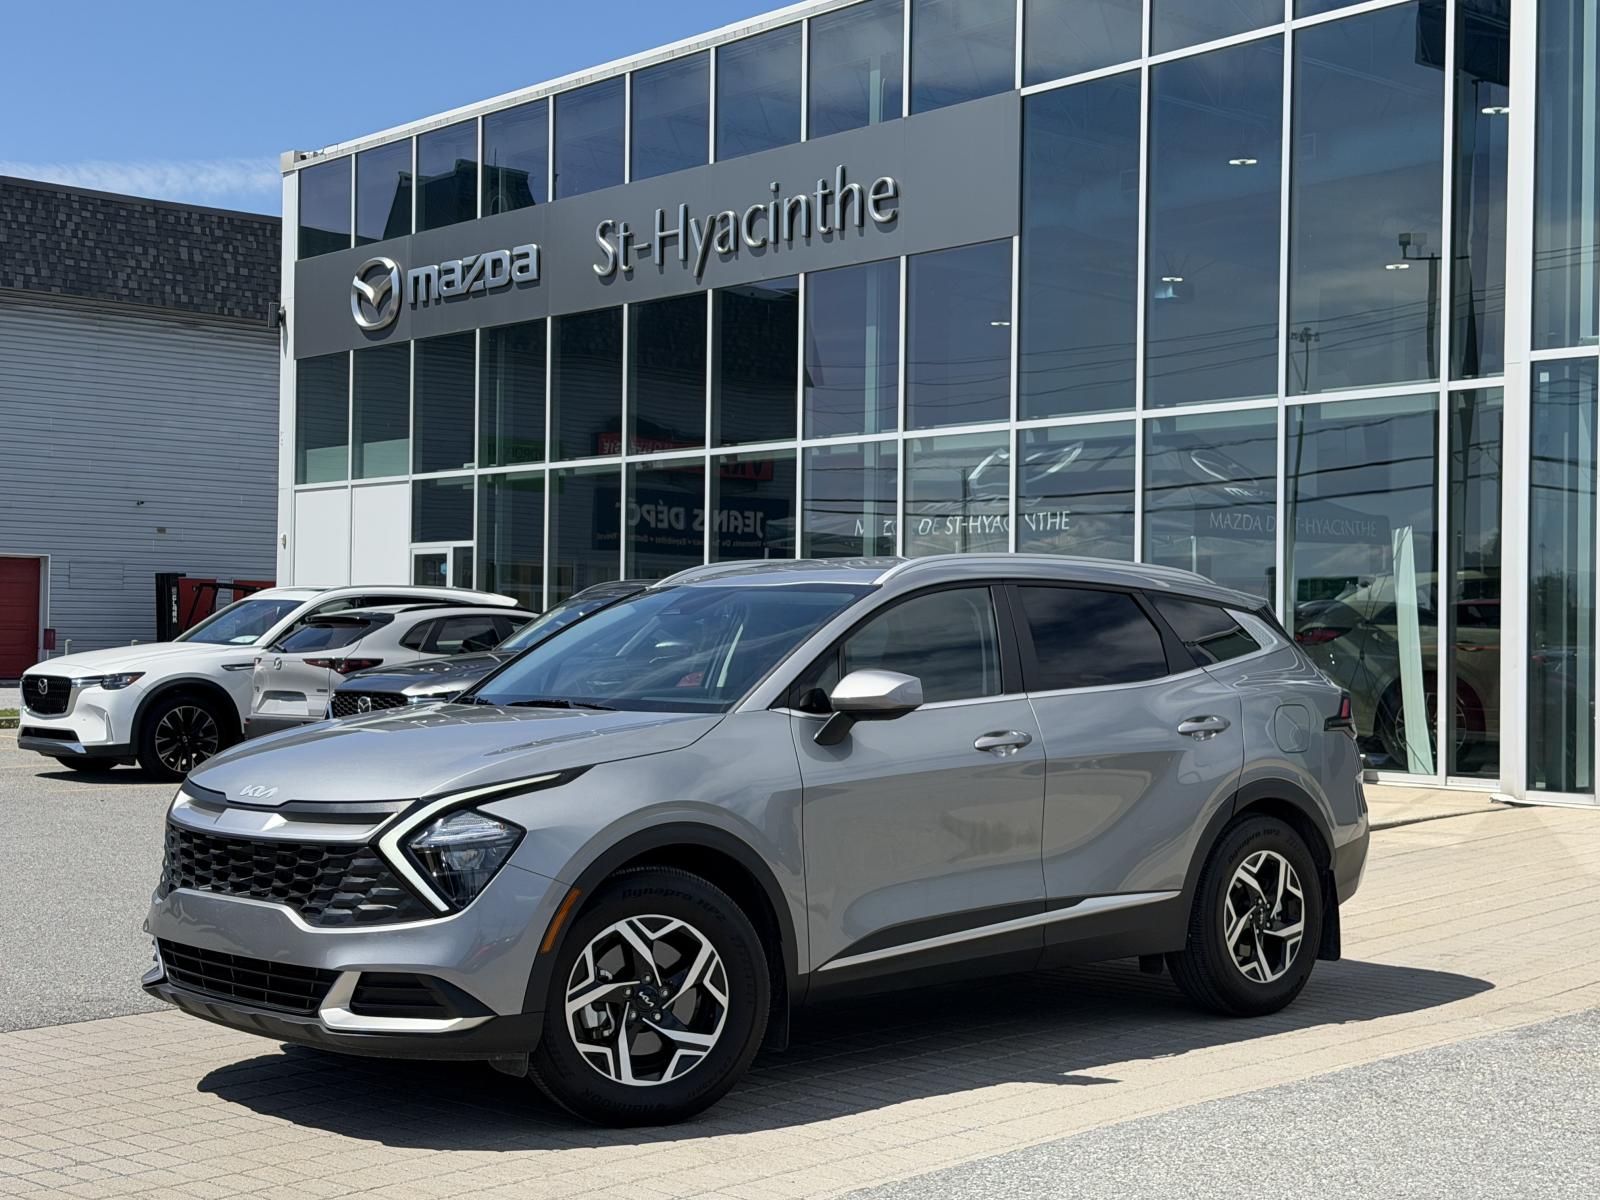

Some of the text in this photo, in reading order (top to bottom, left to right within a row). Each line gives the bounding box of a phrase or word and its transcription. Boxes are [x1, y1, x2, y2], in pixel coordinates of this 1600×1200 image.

[592, 164, 899, 278] St-Hyacinthe
[918, 517, 941, 535] DE
[944, 510, 1071, 536] ST-HYACNTHE
[1209, 512, 1263, 532] MAZDA
[1293, 517, 1377, 537] T-HYACINTHE
